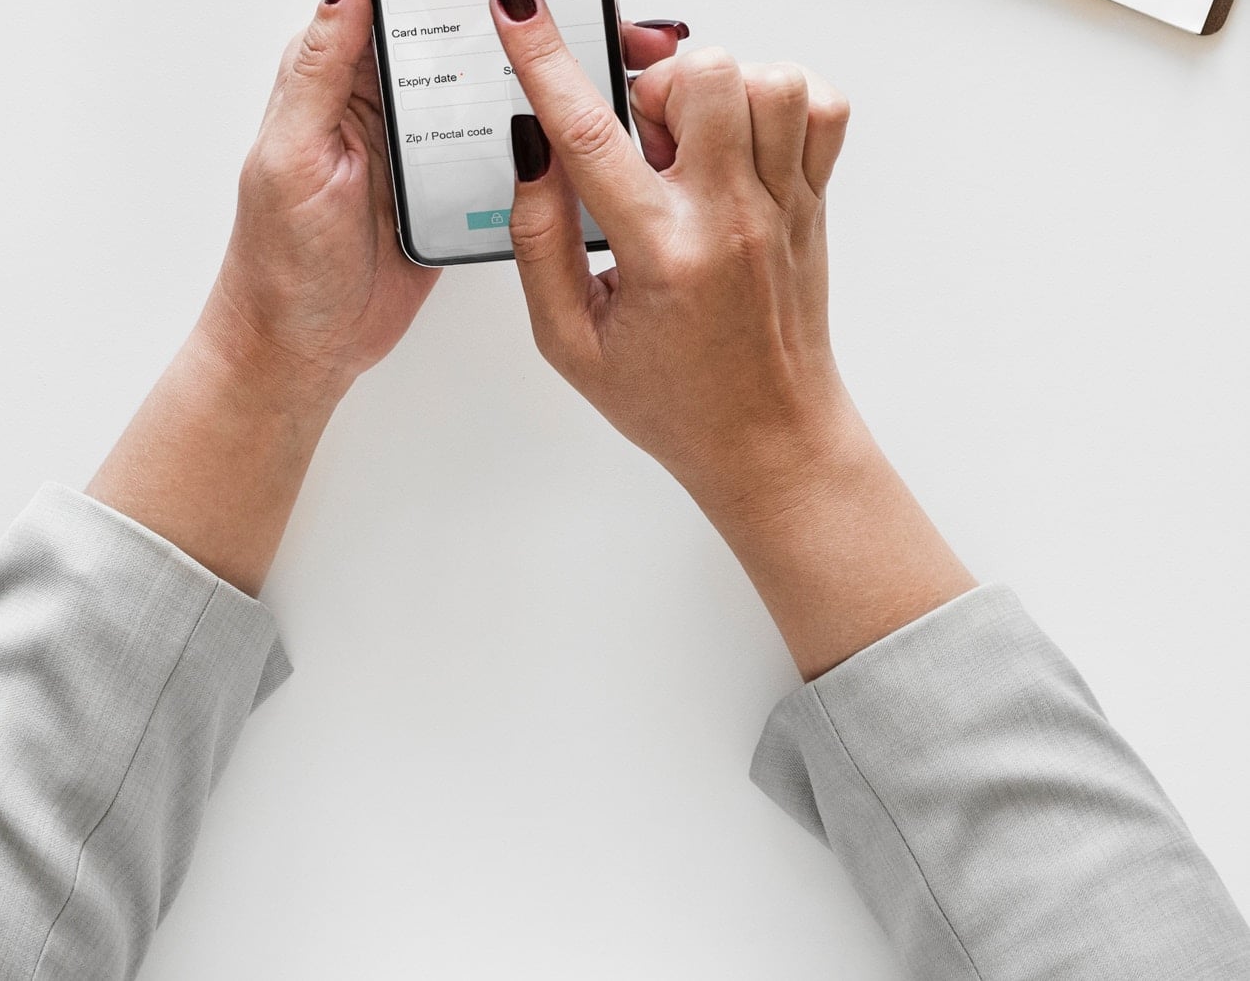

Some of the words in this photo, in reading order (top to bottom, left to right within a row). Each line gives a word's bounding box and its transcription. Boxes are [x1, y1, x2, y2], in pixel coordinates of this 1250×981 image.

[390, 26, 418, 39] Card
[419, 23, 461, 35] number
[397, 75, 431, 88] Expiry
[432, 73, 458, 84] date
[404, 132, 423, 144] Zip
[466, 125, 493, 137] code
